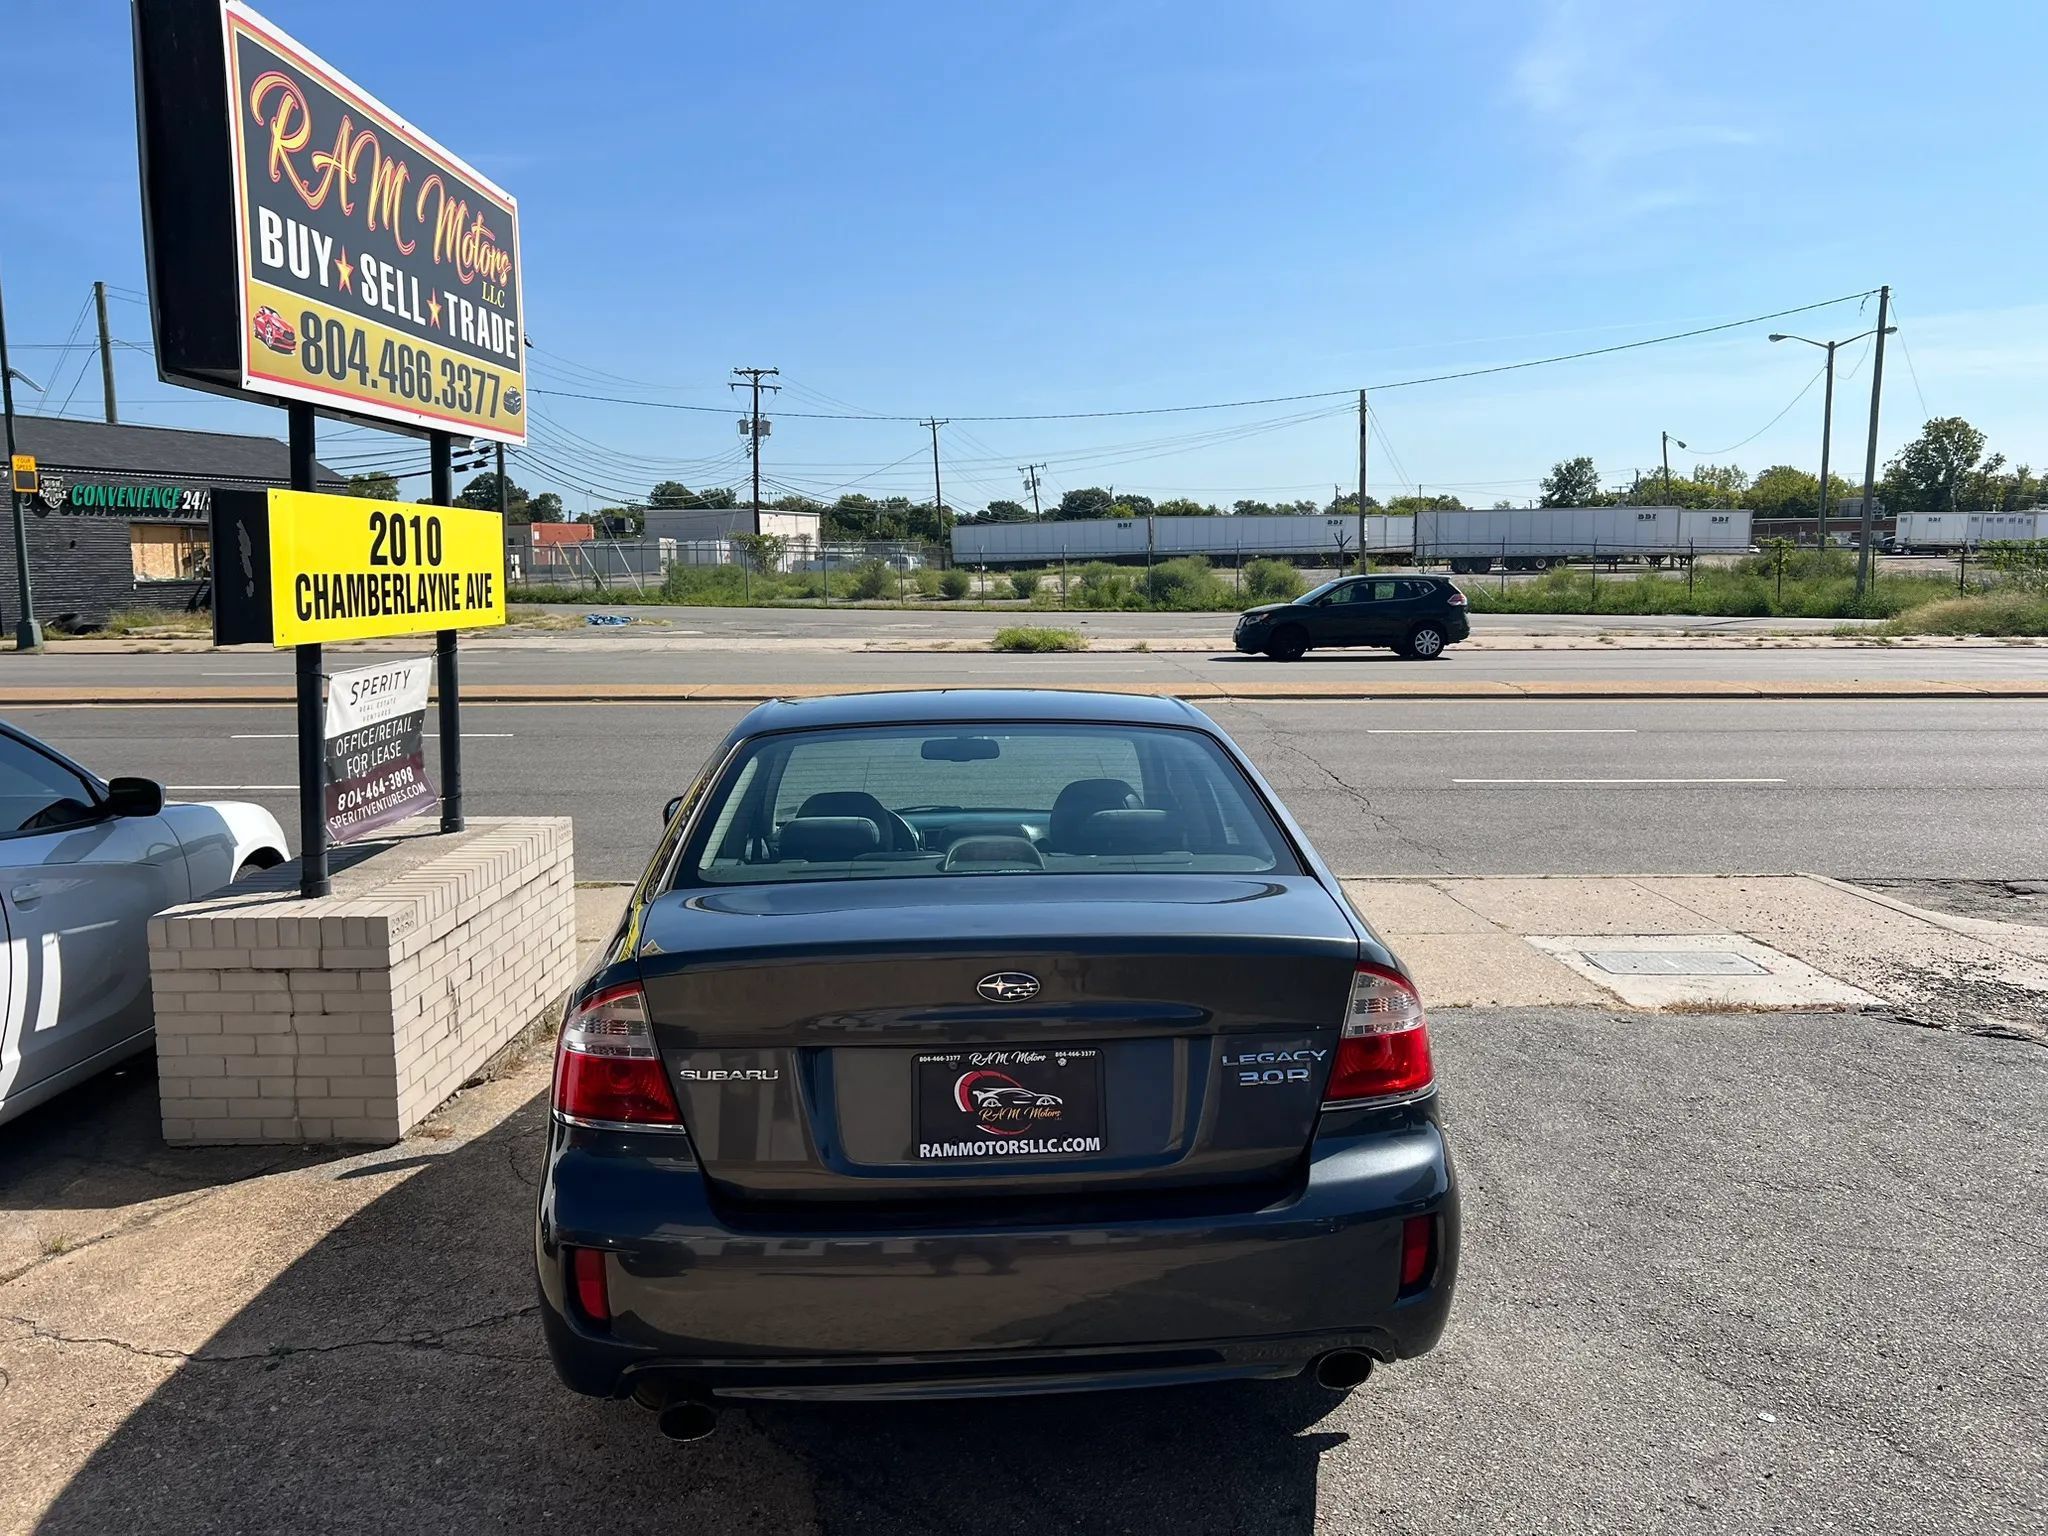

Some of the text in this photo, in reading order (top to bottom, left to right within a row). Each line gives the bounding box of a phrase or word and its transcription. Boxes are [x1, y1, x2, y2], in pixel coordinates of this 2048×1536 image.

[250, 70, 512, 287] RAM Motors
[258, 206, 517, 360] BUY SELL TRADE
[481, 281, 506, 309] LLC
[300, 311, 501, 420] 804.466.3377
[71, 485, 181, 510] CONVENIENCE
[369, 511, 442, 567] 2010
[295, 573, 493, 622] CHAMBERLAYNE AVE
[350, 669, 411, 706] SPERITY
[336, 716, 412, 757] OFFICE/RETAIL
[346, 740, 402, 777] FOR LEASE
[329, 782, 427, 829] SPERITYVENTURES.COM
[337, 766, 415, 812] 804-464-3898
[680, 1069, 779, 1081] SUBARU
[968, 1051, 1047, 1066] RAM Motors
[1222, 1049, 1327, 1066] LEGACY
[979, 1106, 1061, 1121] RAM Motors
[919, 1137, 1101, 1158] RAMMOTORSLLC.COM
